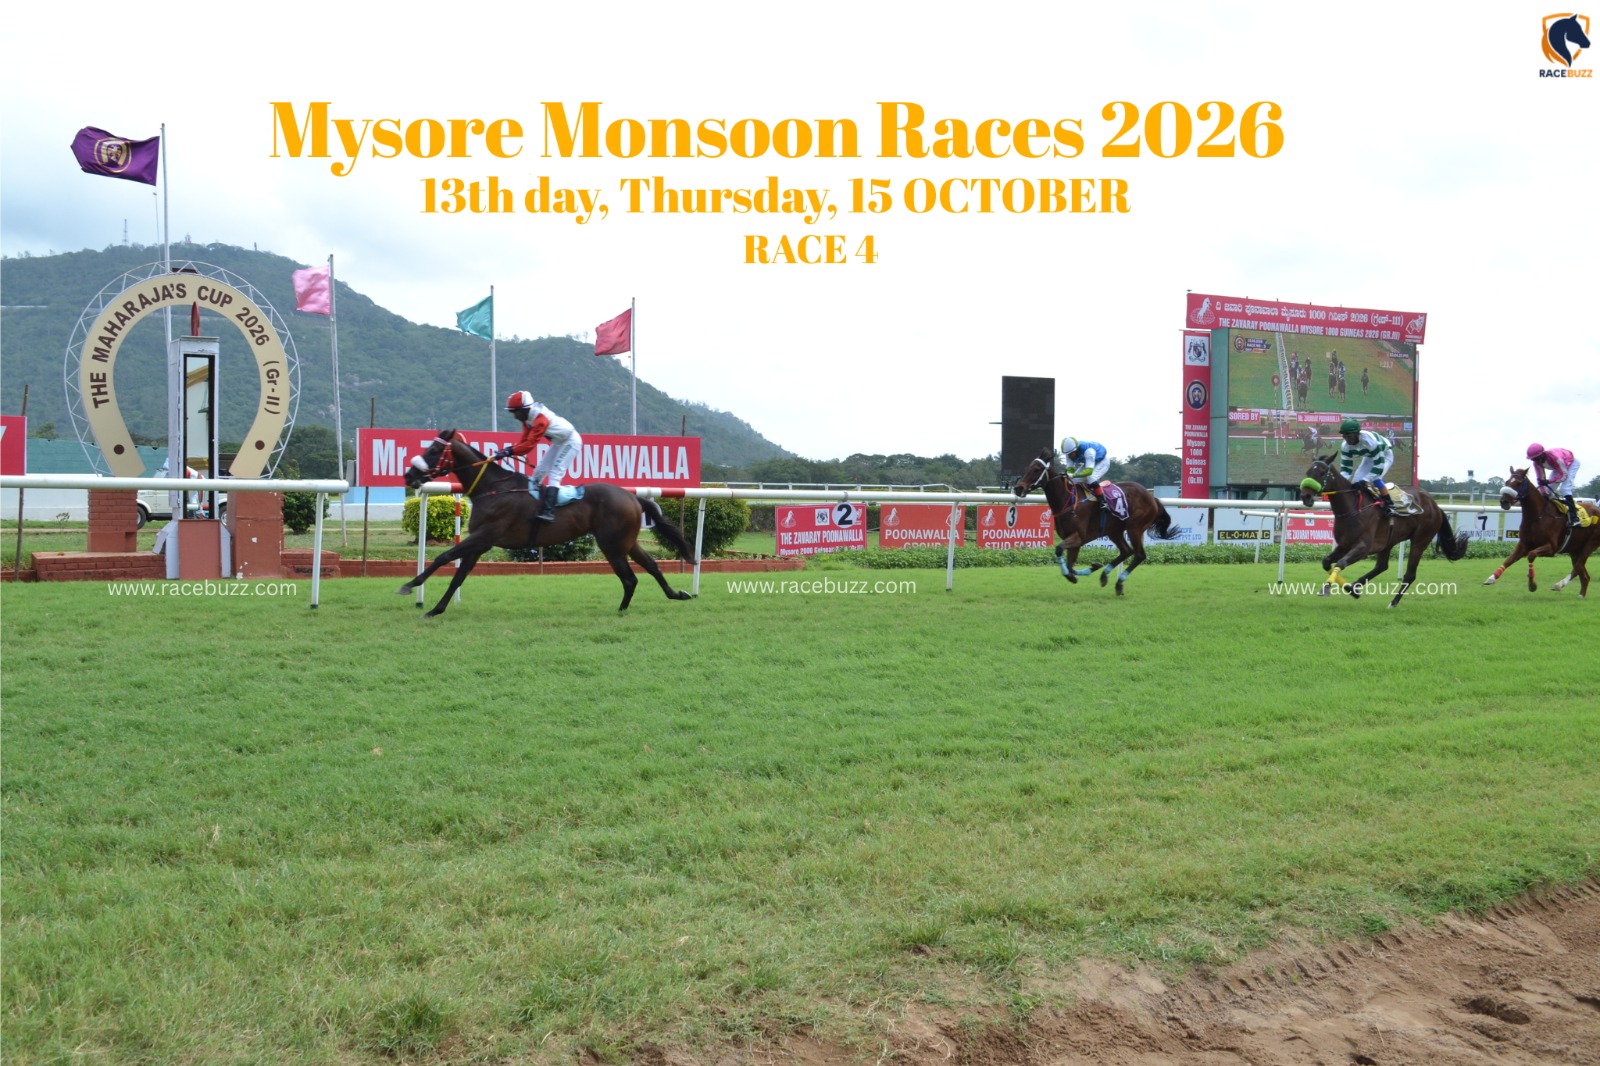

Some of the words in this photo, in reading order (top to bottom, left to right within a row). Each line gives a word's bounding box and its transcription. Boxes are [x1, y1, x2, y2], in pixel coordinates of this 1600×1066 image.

[1219, 317, 1230, 328] THE
[1300, 324, 1324, 336] MYSORE
[90, 372, 110, 409] THE
[197, 285, 233, 309] CUP
[235, 307, 270, 347] 2026
[1250, 412, 1259, 421] BY
[536, 443, 690, 480] PONAWALLA
[837, 503, 853, 526] 2
[1115, 497, 1127, 516] 4
[1008, 506, 1015, 527] 3
[1478, 515, 1488, 531] 7
[780, 532, 793, 545] THE
[793, 530, 821, 545] ZAVARAY
[822, 528, 864, 543] POONAWALLA
[982, 528, 1050, 540] POONAWALLA
